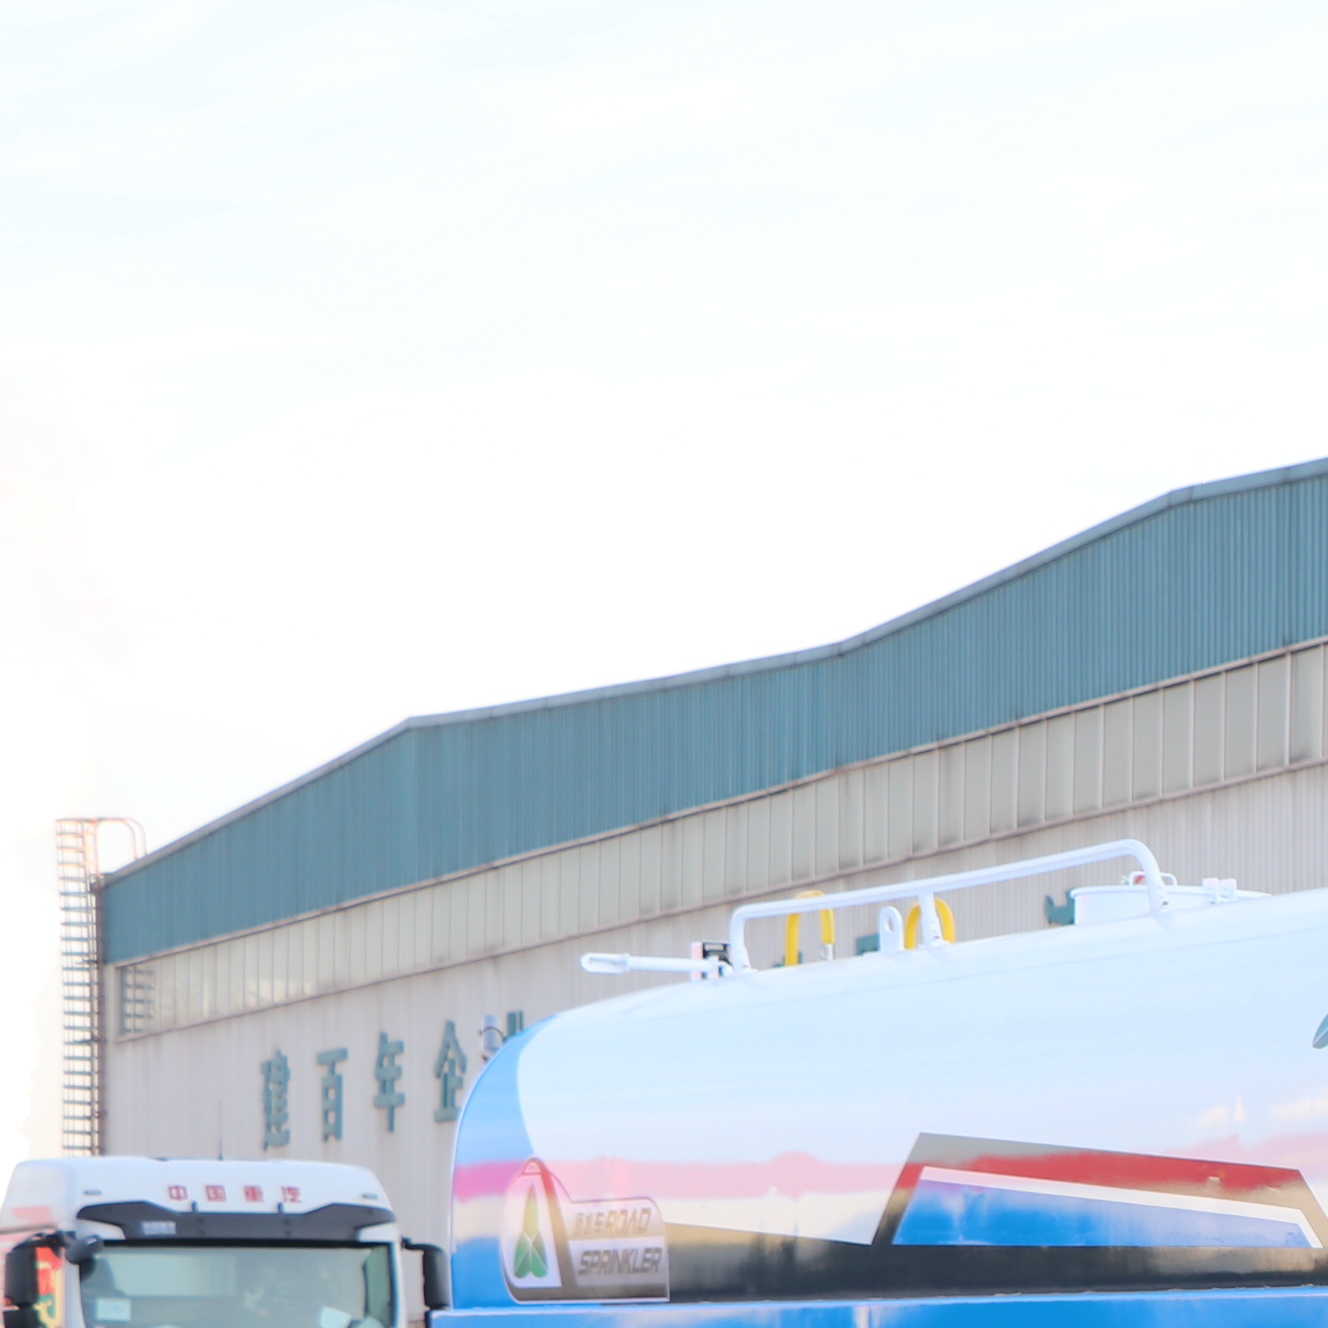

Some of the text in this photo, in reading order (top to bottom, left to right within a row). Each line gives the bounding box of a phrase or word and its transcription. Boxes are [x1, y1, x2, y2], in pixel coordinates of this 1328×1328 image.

[260, 1010, 524, 1152] 建百年企
[577, 1246, 664, 1277] SPRINKLER
